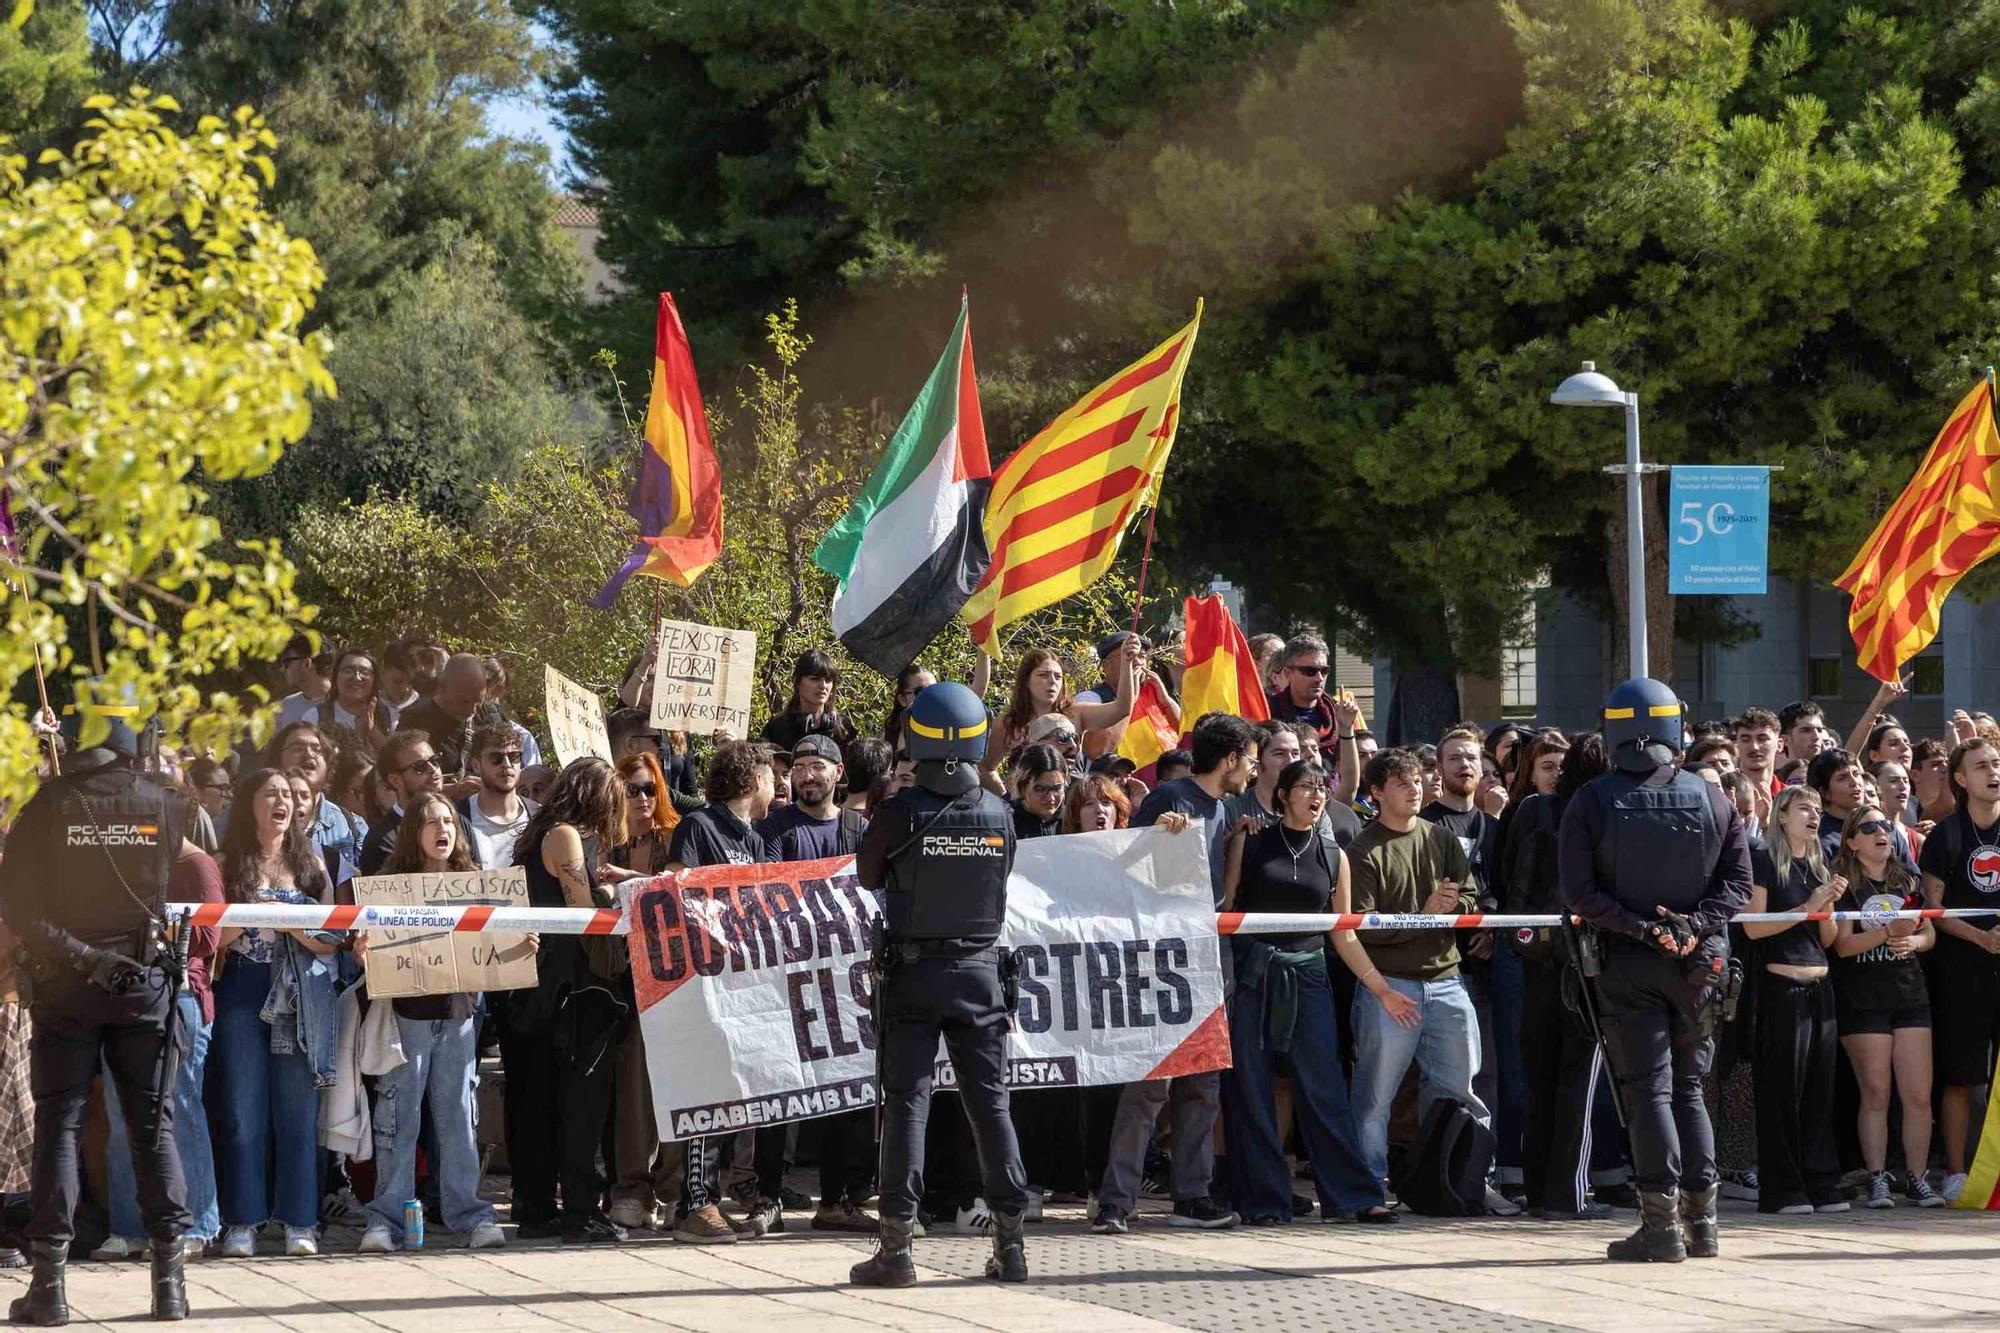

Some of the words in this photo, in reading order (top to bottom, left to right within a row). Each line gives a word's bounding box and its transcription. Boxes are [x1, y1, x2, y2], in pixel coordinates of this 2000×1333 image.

[661, 626, 739, 653] FEIXISTES
[670, 656, 712, 676] FORA
[667, 683, 684, 695] DE
[697, 686, 712, 697] LA
[657, 702, 746, 728] UNIVERSITAT
[68, 824, 141, 835] POLICIA
[67, 835, 158, 846] NACIONAL
[923, 836, 988, 846] POLICIA
[923, 846, 1003, 856] NACIONAL
[358, 879, 413, 895] RATAS
[422, 876, 526, 898] FASCISTAS
[379, 916, 405, 926] LINEA
[407, 916, 420, 926] DE
[421, 916, 455, 927] POLICIA
[394, 907, 407, 915] NO
[409, 907, 439, 916] PASAR
[639, 874, 887, 982] COMBAT
[1407, 921, 1418, 929] DE
[396, 955, 412, 971] DE
[427, 954, 444, 966] LA
[472, 943, 502, 966] UA
[1000, 937, 1193, 1034] STRES
[786, 960, 879, 1062] ELS
[675, 1102, 783, 1135] ACABEM
[786, 1088, 842, 1117] AMB
[846, 1082, 876, 1106] LA
